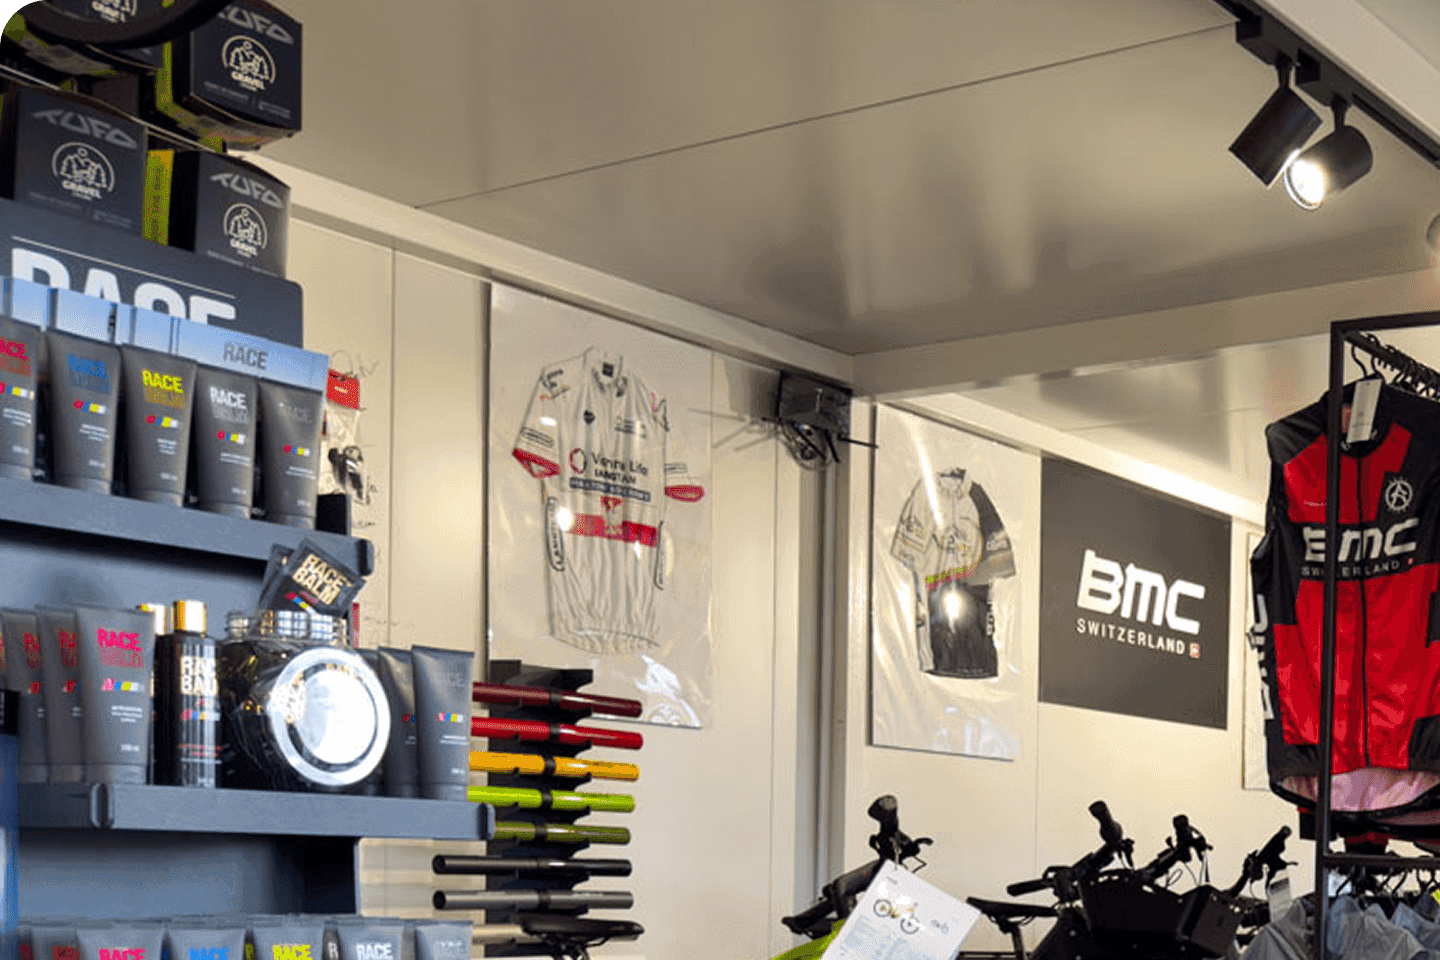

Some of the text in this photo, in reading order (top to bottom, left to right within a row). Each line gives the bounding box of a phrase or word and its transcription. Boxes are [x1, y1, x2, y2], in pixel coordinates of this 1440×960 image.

[218, 5, 294, 44] UFO
[210, 172, 285, 209] TUFO
[0, 337, 29, 361] ACE
[223, 341, 267, 369] RACE
[141, 369, 184, 394] RACE
[209, 386, 247, 410] RACE
[302, 553, 346, 588] RACE
[1300, 560, 1401, 577] SWIERLAND
[292, 568, 342, 605] BALM
[1077, 549, 1206, 635] BMC
[97, 627, 142, 652] RACE
[1076, 617, 1186, 656] SWITZERLAND
[355, 942, 393, 960] RACE
